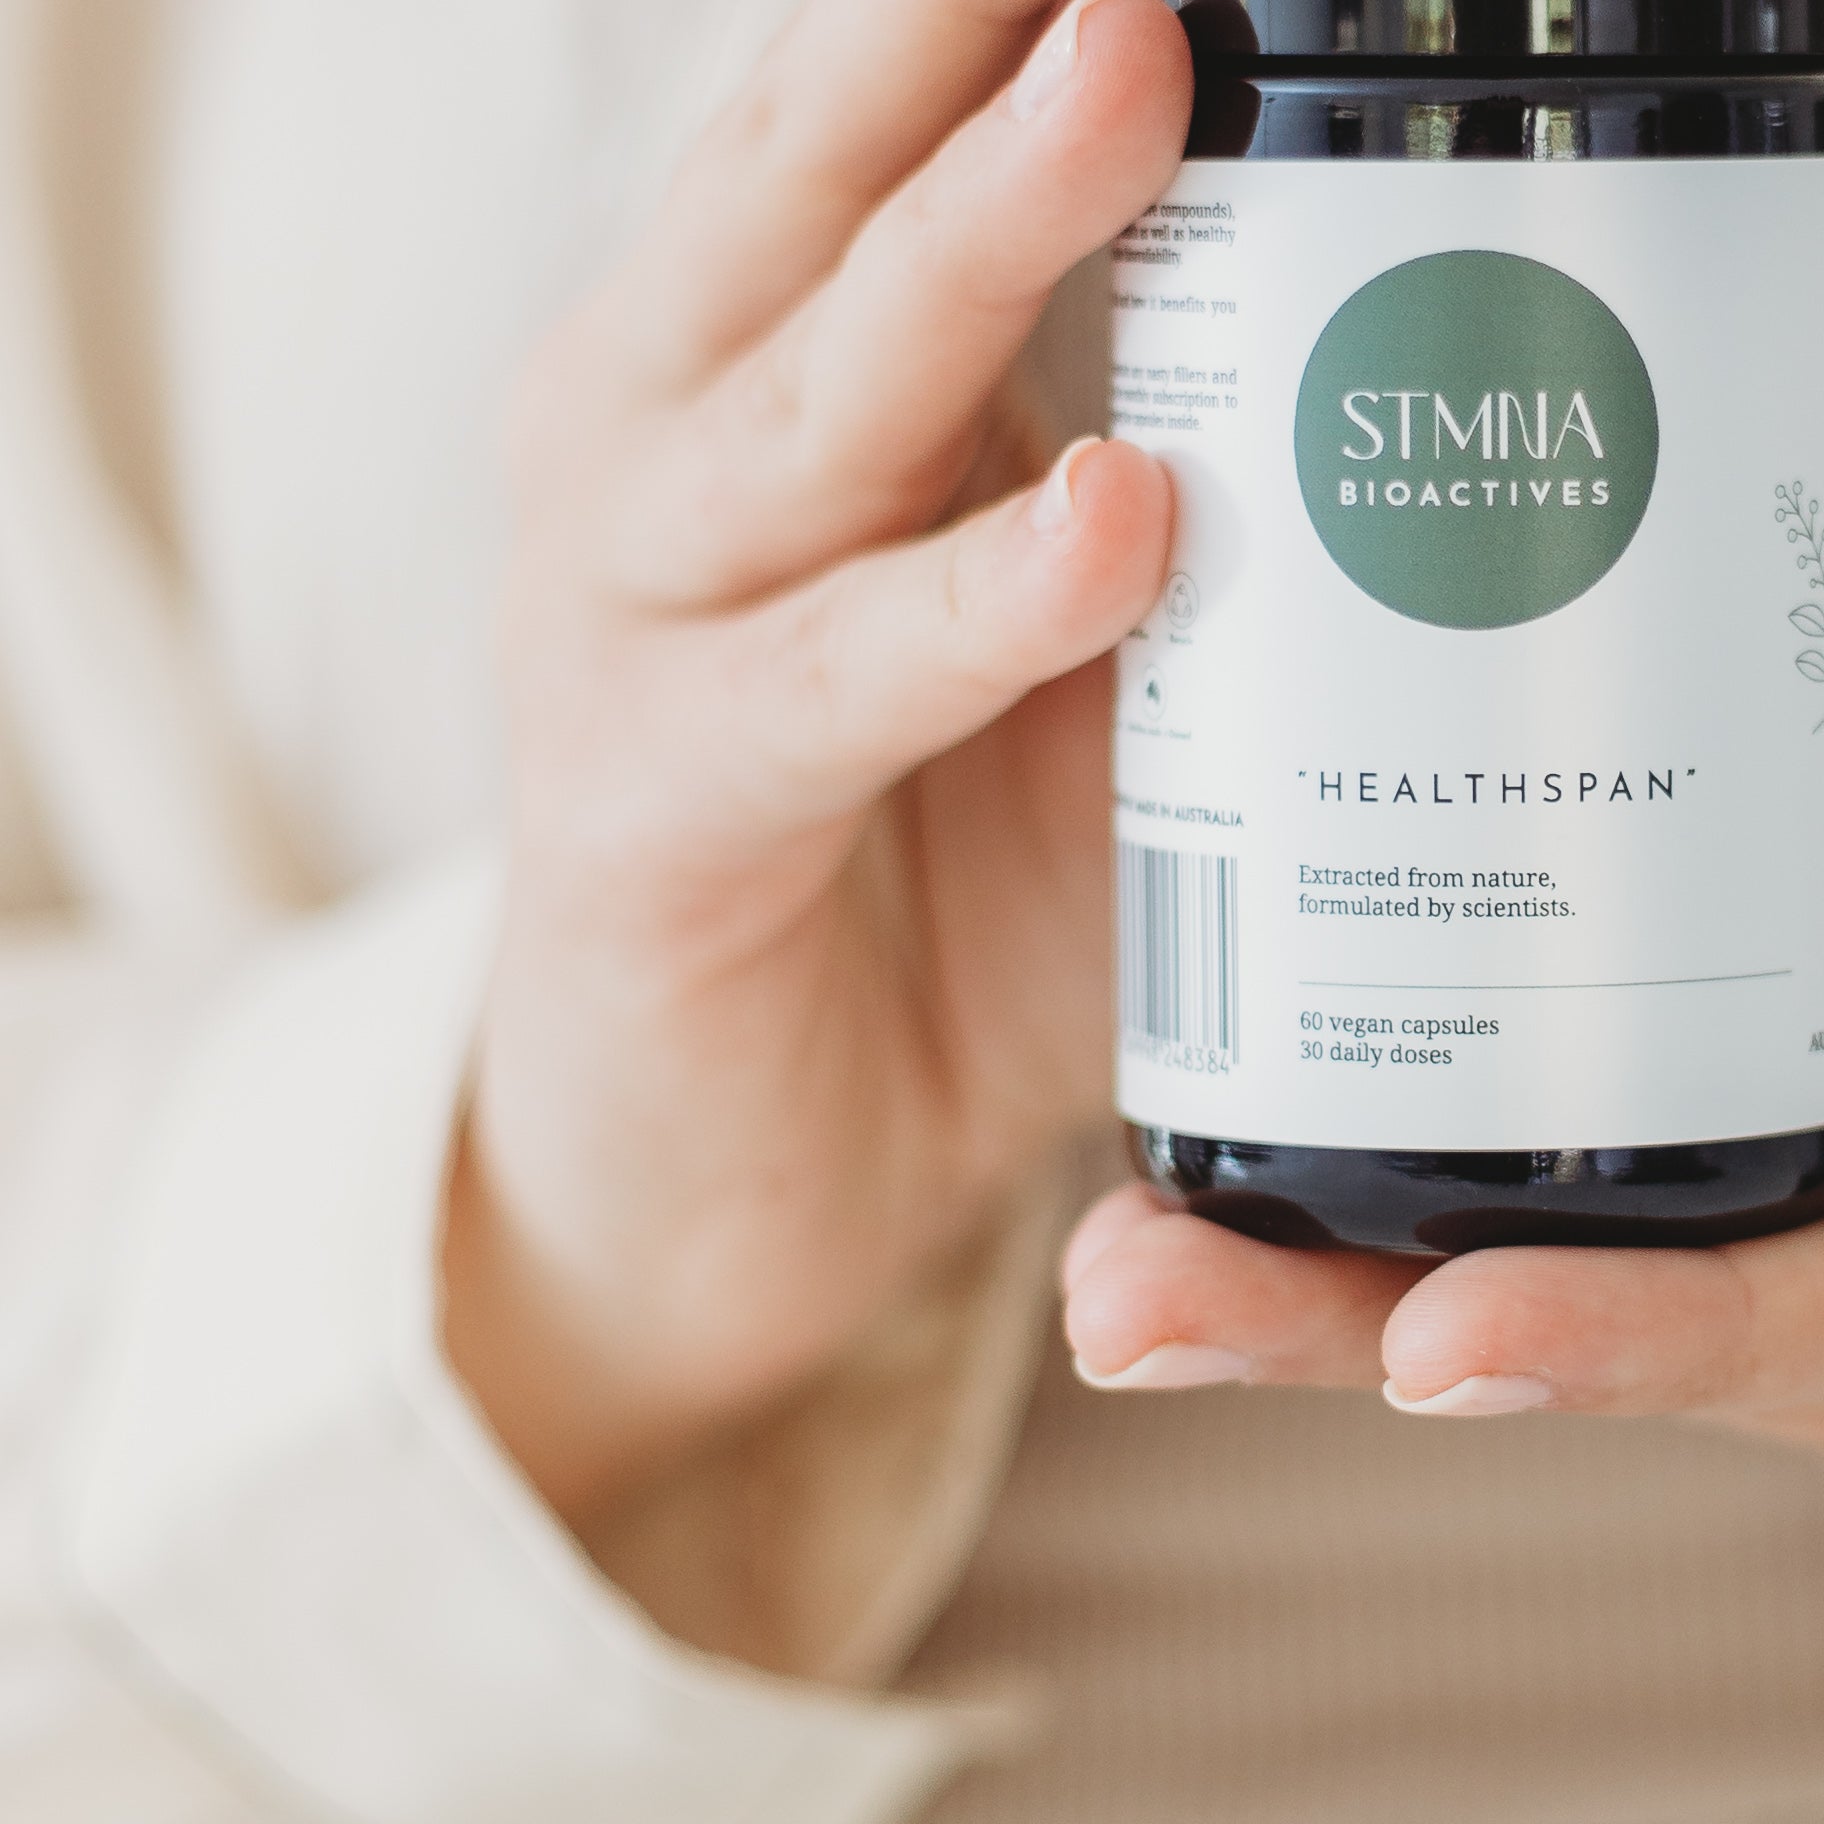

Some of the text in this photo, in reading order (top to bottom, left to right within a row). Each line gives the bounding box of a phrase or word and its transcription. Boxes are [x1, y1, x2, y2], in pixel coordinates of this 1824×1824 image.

[1161, 203, 1235, 221] compounds),
[1173, 229, 1185, 242] as
[1189, 226, 1235, 246] healthy
[1160, 294, 1207, 313] benefits
[1211, 300, 1236, 317] you
[1173, 366, 1207, 384] fillers
[1212, 369, 1237, 384] and
[1153, 388, 1219, 410] subscription
[1224, 392, 1239, 409] to
[1167, 416, 1203, 431] inside.
[1342, 392, 1604, 460] STMNA
[1338, 479, 1611, 507] BIOACTIVES
[1174, 807, 1245, 827] AUSTRALIA
[1298, 865, 1557, 892] Extracted from nature,
[1298, 893, 1577, 923] formulated by scientists.
[1300, 1011, 1500, 1041] 60 vegan capsules
[1300, 1040, 1453, 1068] 30 daily doses
